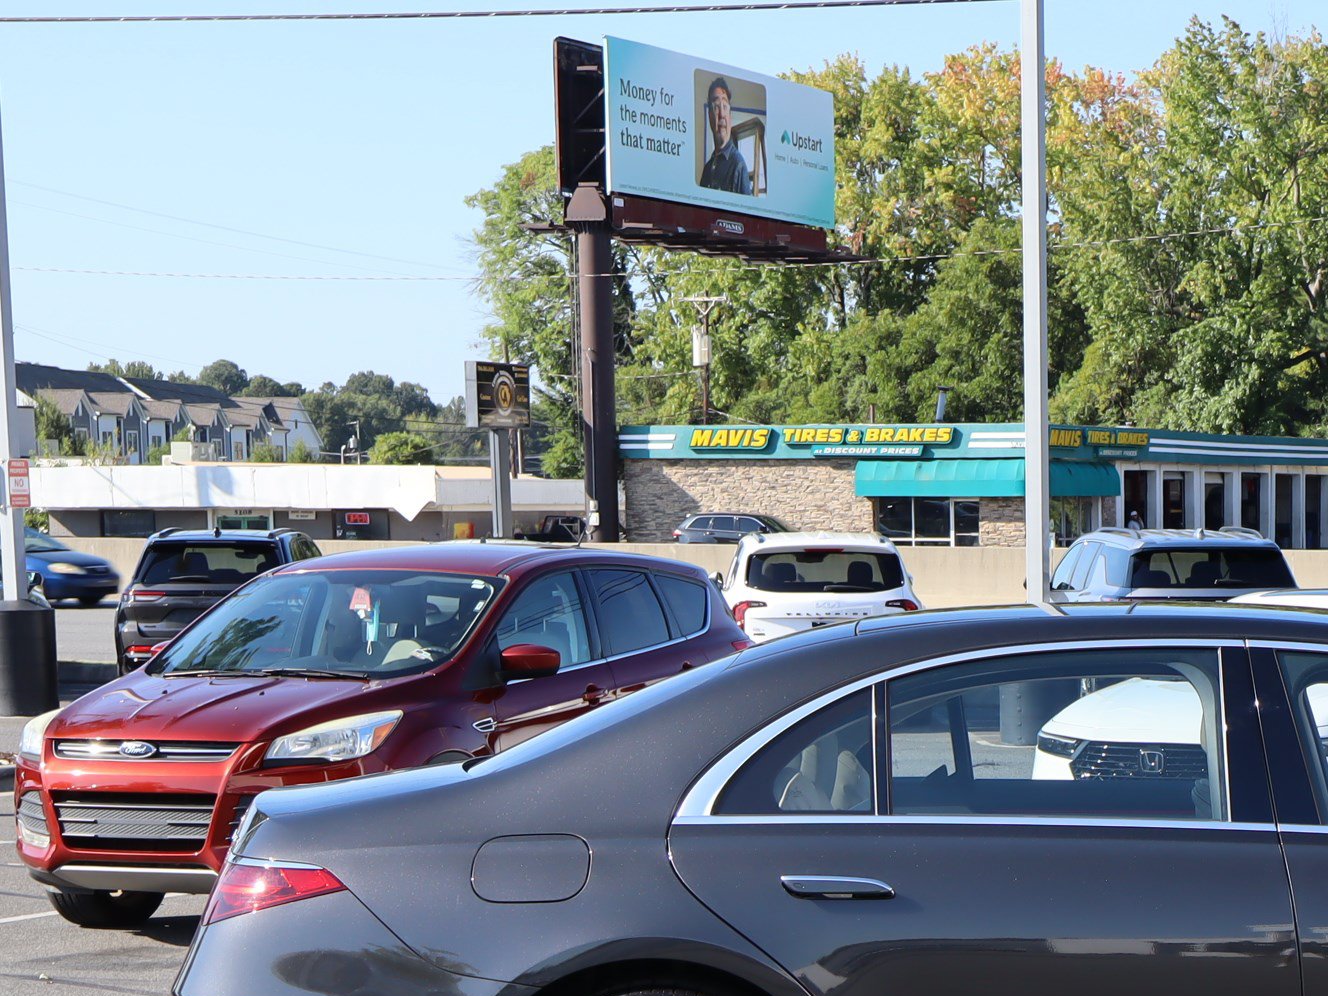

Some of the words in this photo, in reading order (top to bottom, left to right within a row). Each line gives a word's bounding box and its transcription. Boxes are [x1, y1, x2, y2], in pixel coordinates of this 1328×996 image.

[620, 77, 657, 107] Money
[660, 87, 674, 106] for
[620, 104, 637, 123] the
[640, 112, 687, 133] moments
[621, 127, 643, 149] that
[792, 132, 822, 153] Upstart
[690, 429, 769, 447] MAVIS
[783, 428, 843, 442] TIRES
[849, 430, 860, 441] &
[865, 428, 953, 442] BRAKES
[1050, 429, 1082, 447] MAVIS
[1087, 430, 1111, 444] TIRES
[1117, 431, 1148, 445] BRAKES
[823, 447, 877, 455] DISCOUNT
[14, 478, 24, 488] NO
